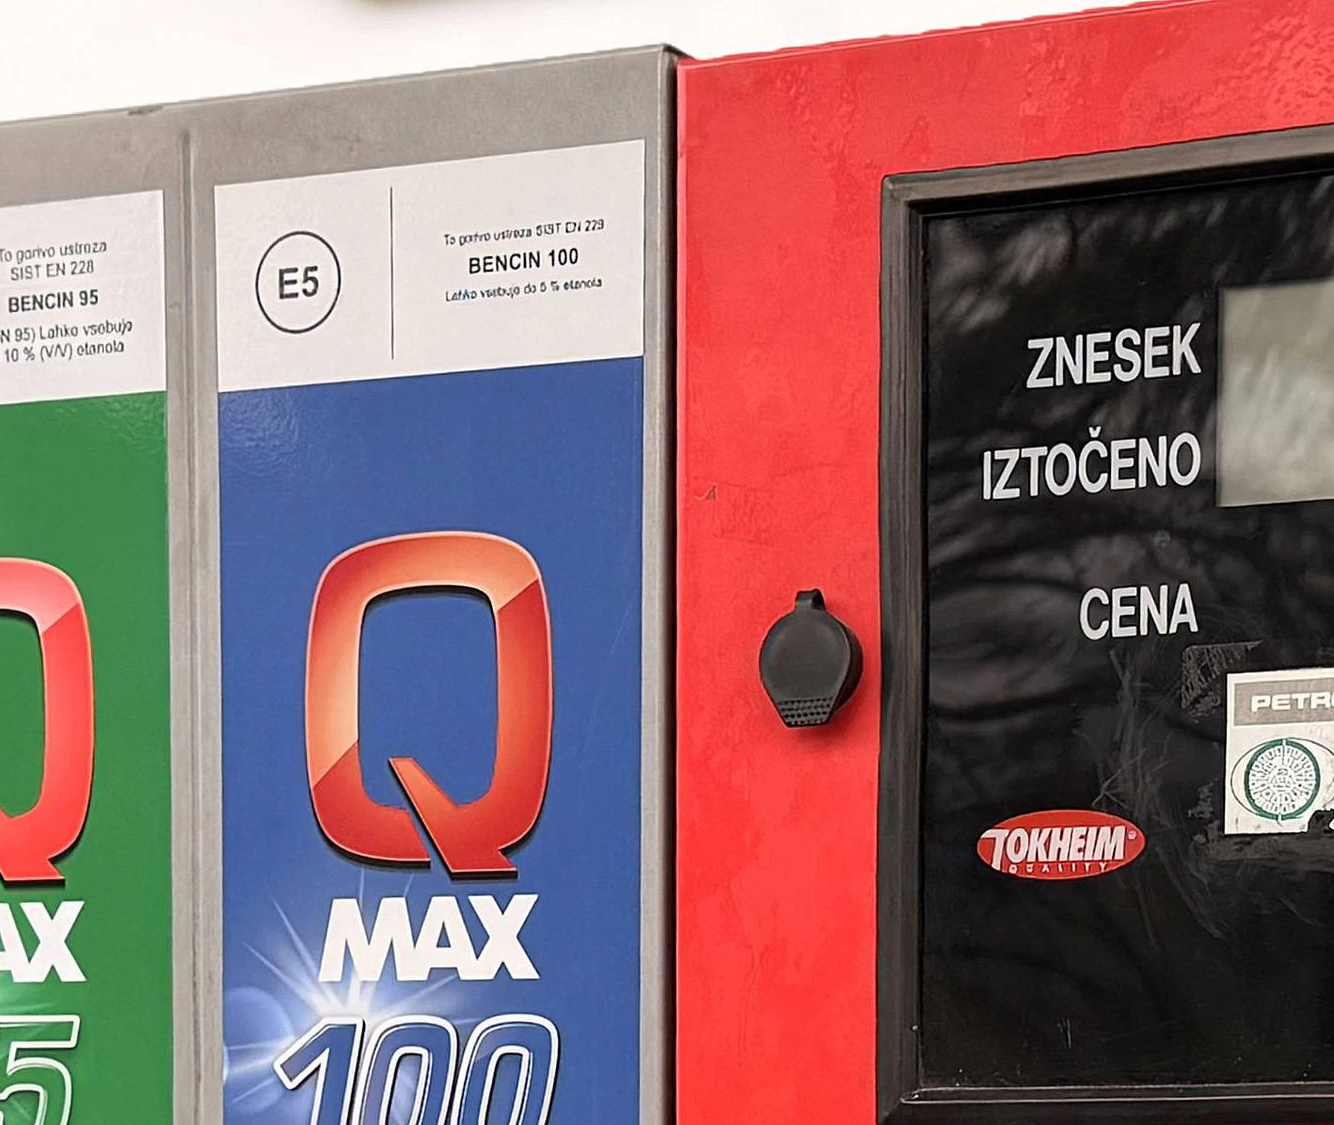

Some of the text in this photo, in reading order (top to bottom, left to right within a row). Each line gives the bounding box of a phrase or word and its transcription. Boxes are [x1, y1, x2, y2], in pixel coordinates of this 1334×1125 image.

[278, 265, 320, 300] E5
[469, 247, 579, 274] BENCIN 100
[8, 289, 99, 313] BENCIN 95
[1027, 322, 1203, 390] ZNESEK
[982, 426, 1203, 502] IZTOČENO
[1079, 583, 1199, 642] CENA
[305, 531, 553, 876] Q
[980, 825, 1126, 871] TOKHEIM
[318, 893, 539, 982] MAX
